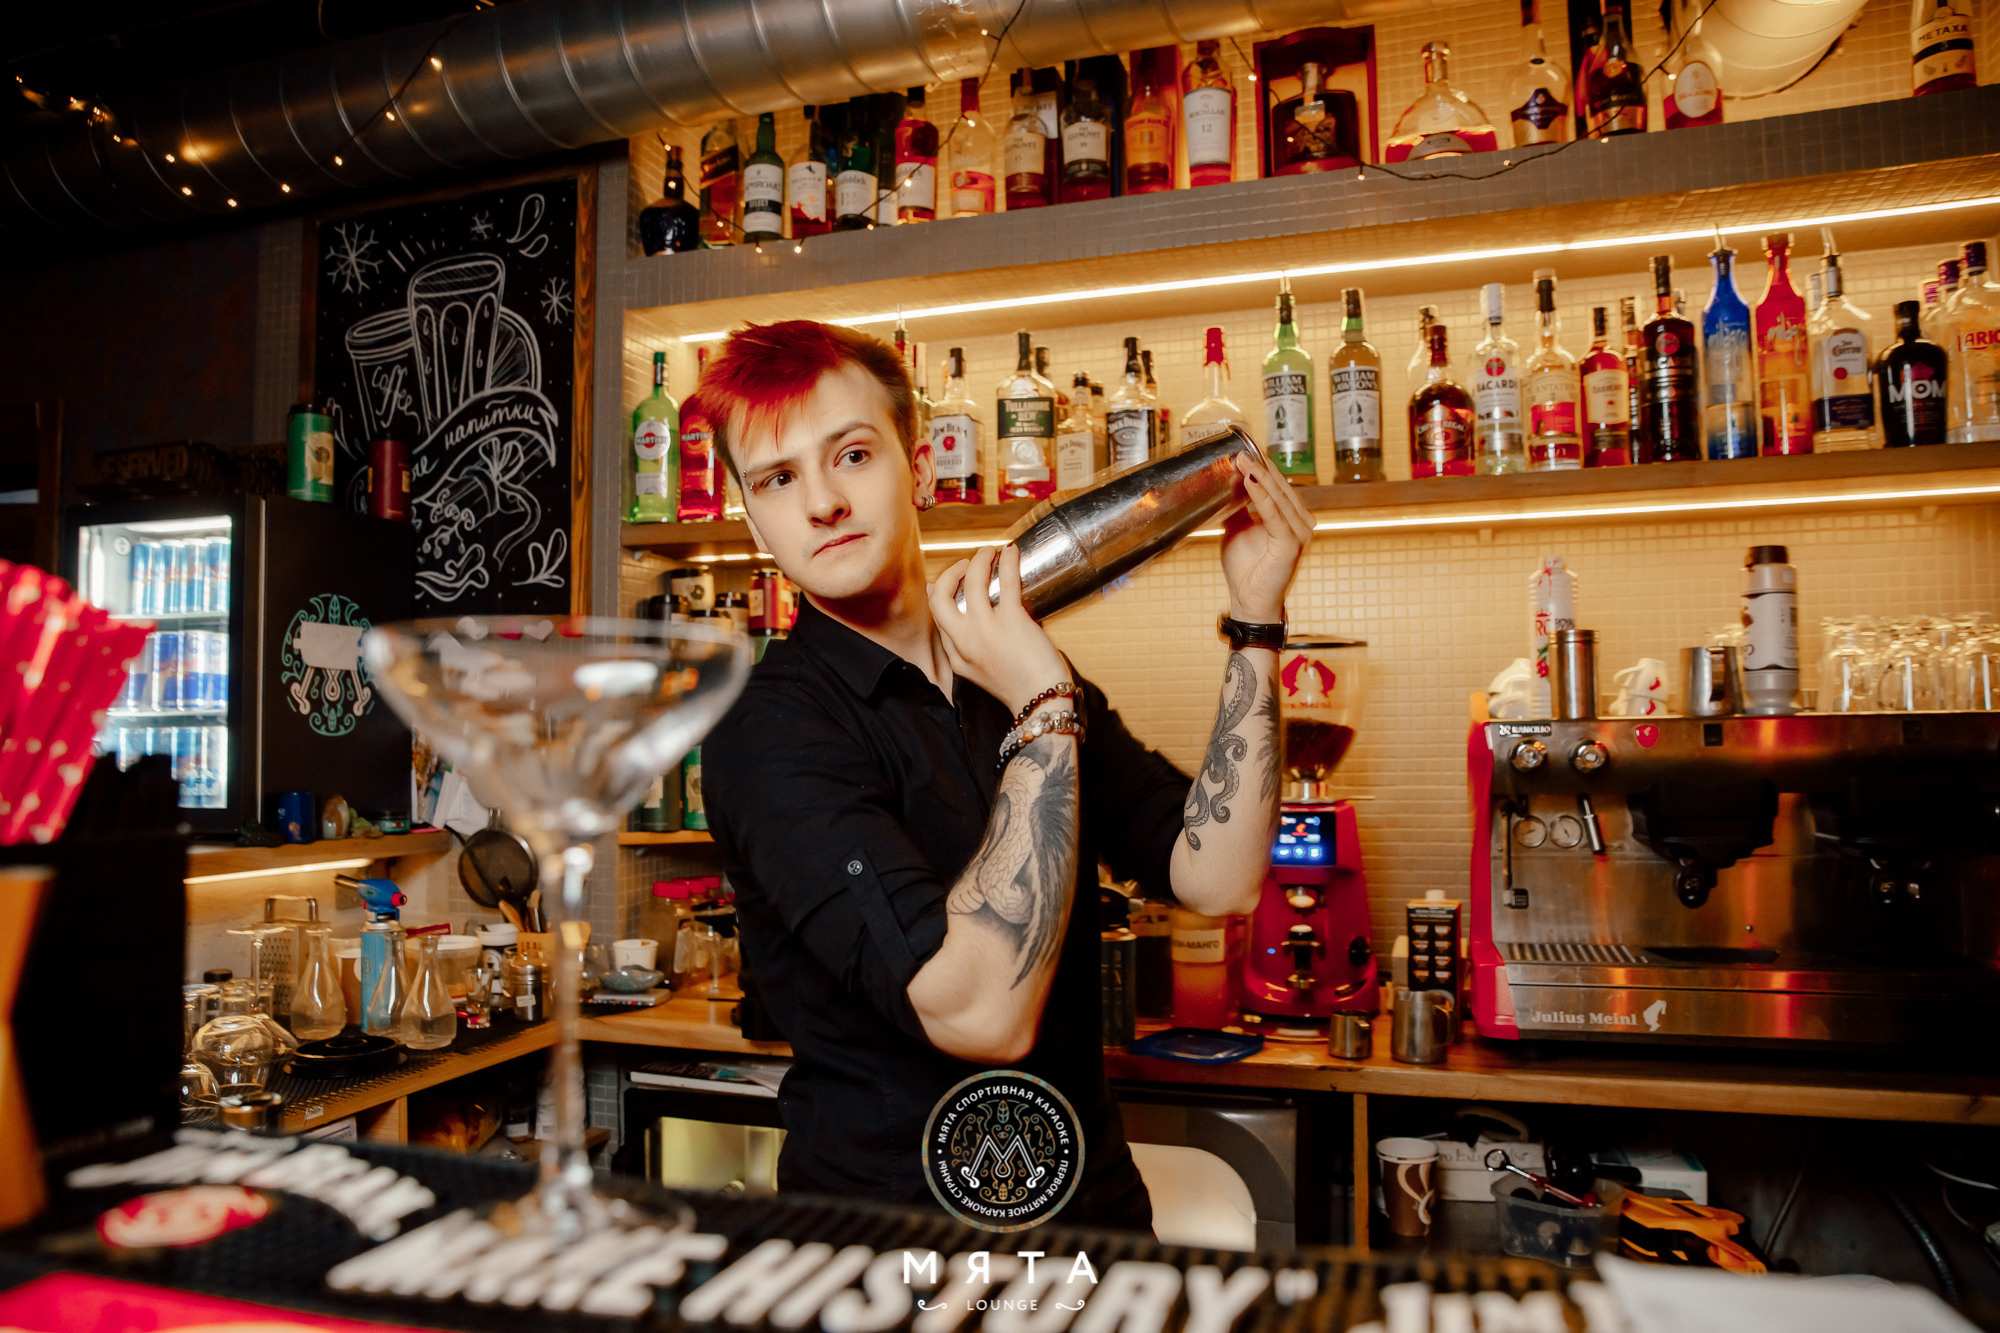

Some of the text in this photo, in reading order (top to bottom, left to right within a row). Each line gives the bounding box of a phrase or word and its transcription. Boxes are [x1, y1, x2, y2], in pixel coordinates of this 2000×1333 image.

[1918, 24, 1968, 41] METAXA
[1332, 371, 1376, 384] WILLIAM
[1477, 380, 1518, 392] BACARDI
[371, 364, 419, 429] Coffee
[1887, 379, 1947, 404] MOM
[445, 395, 541, 450] напитки
[1532, 1010, 1638, 1026] Julius Meinl
